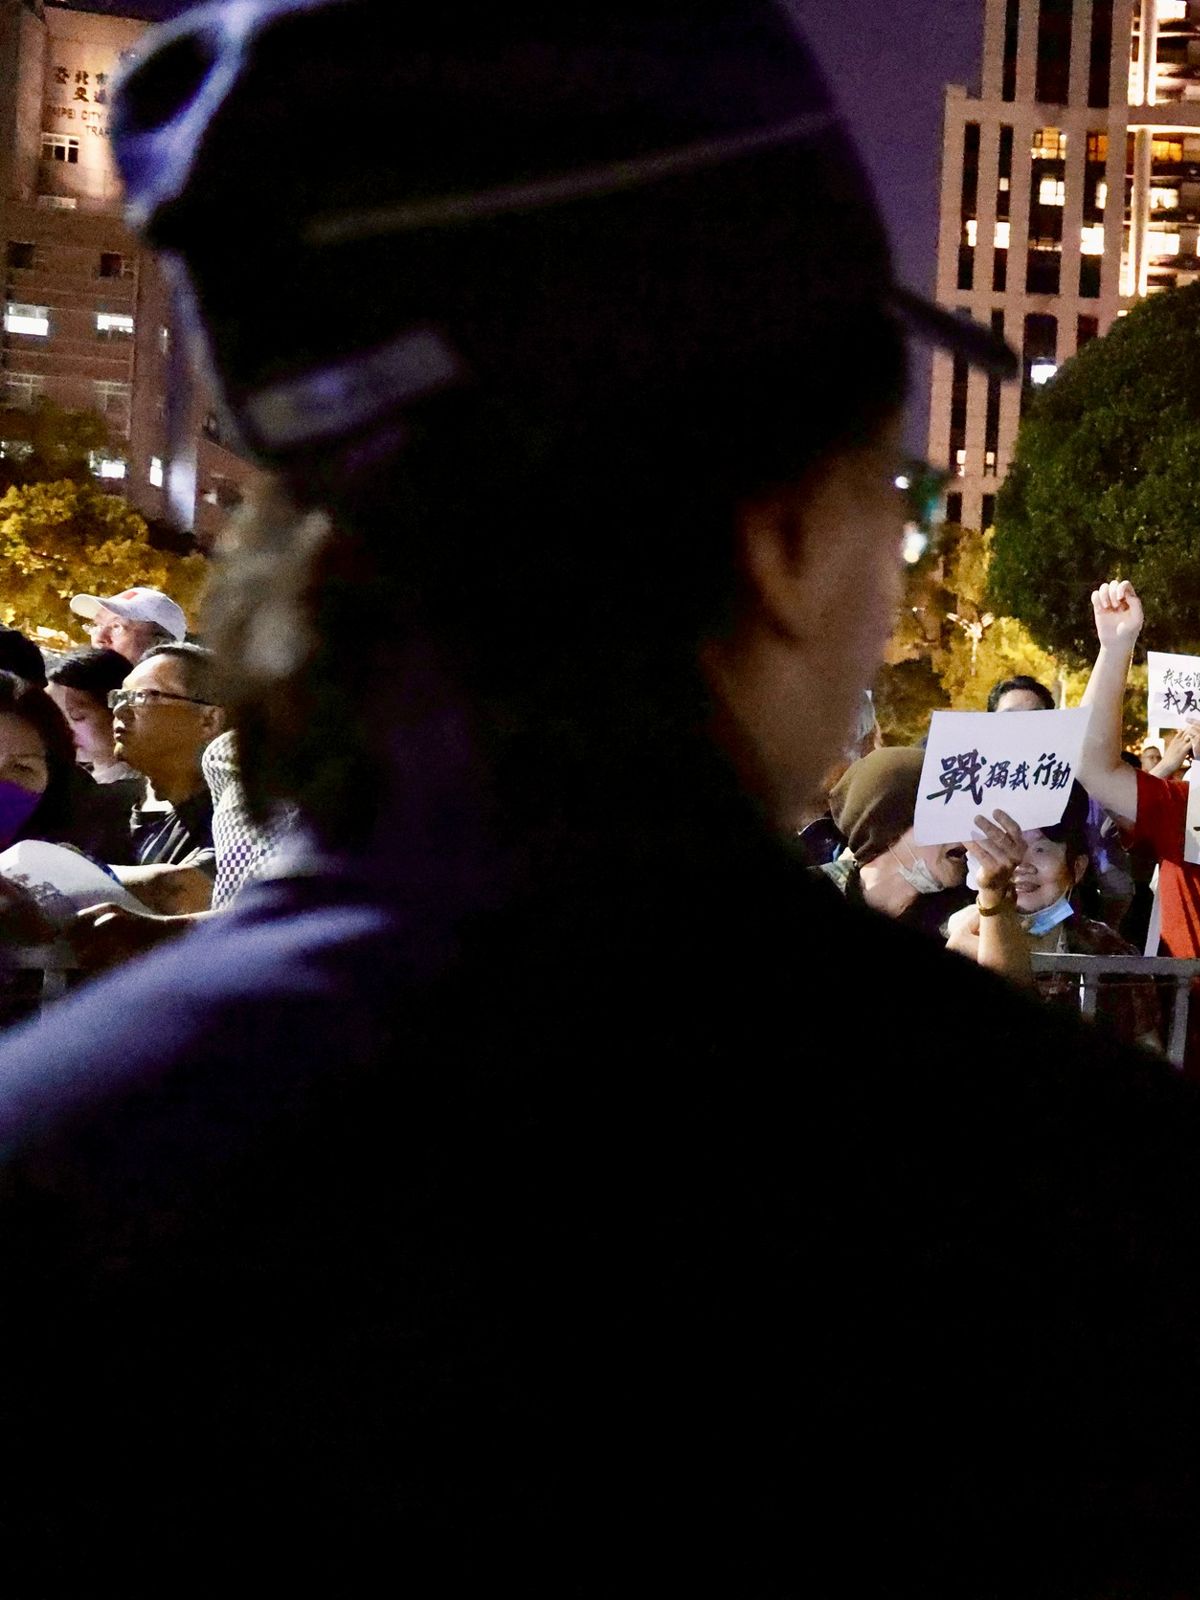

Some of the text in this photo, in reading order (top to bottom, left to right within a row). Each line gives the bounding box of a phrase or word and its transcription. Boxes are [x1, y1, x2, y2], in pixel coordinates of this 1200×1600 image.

[926, 749, 1071, 805] 戰獨裁行動
